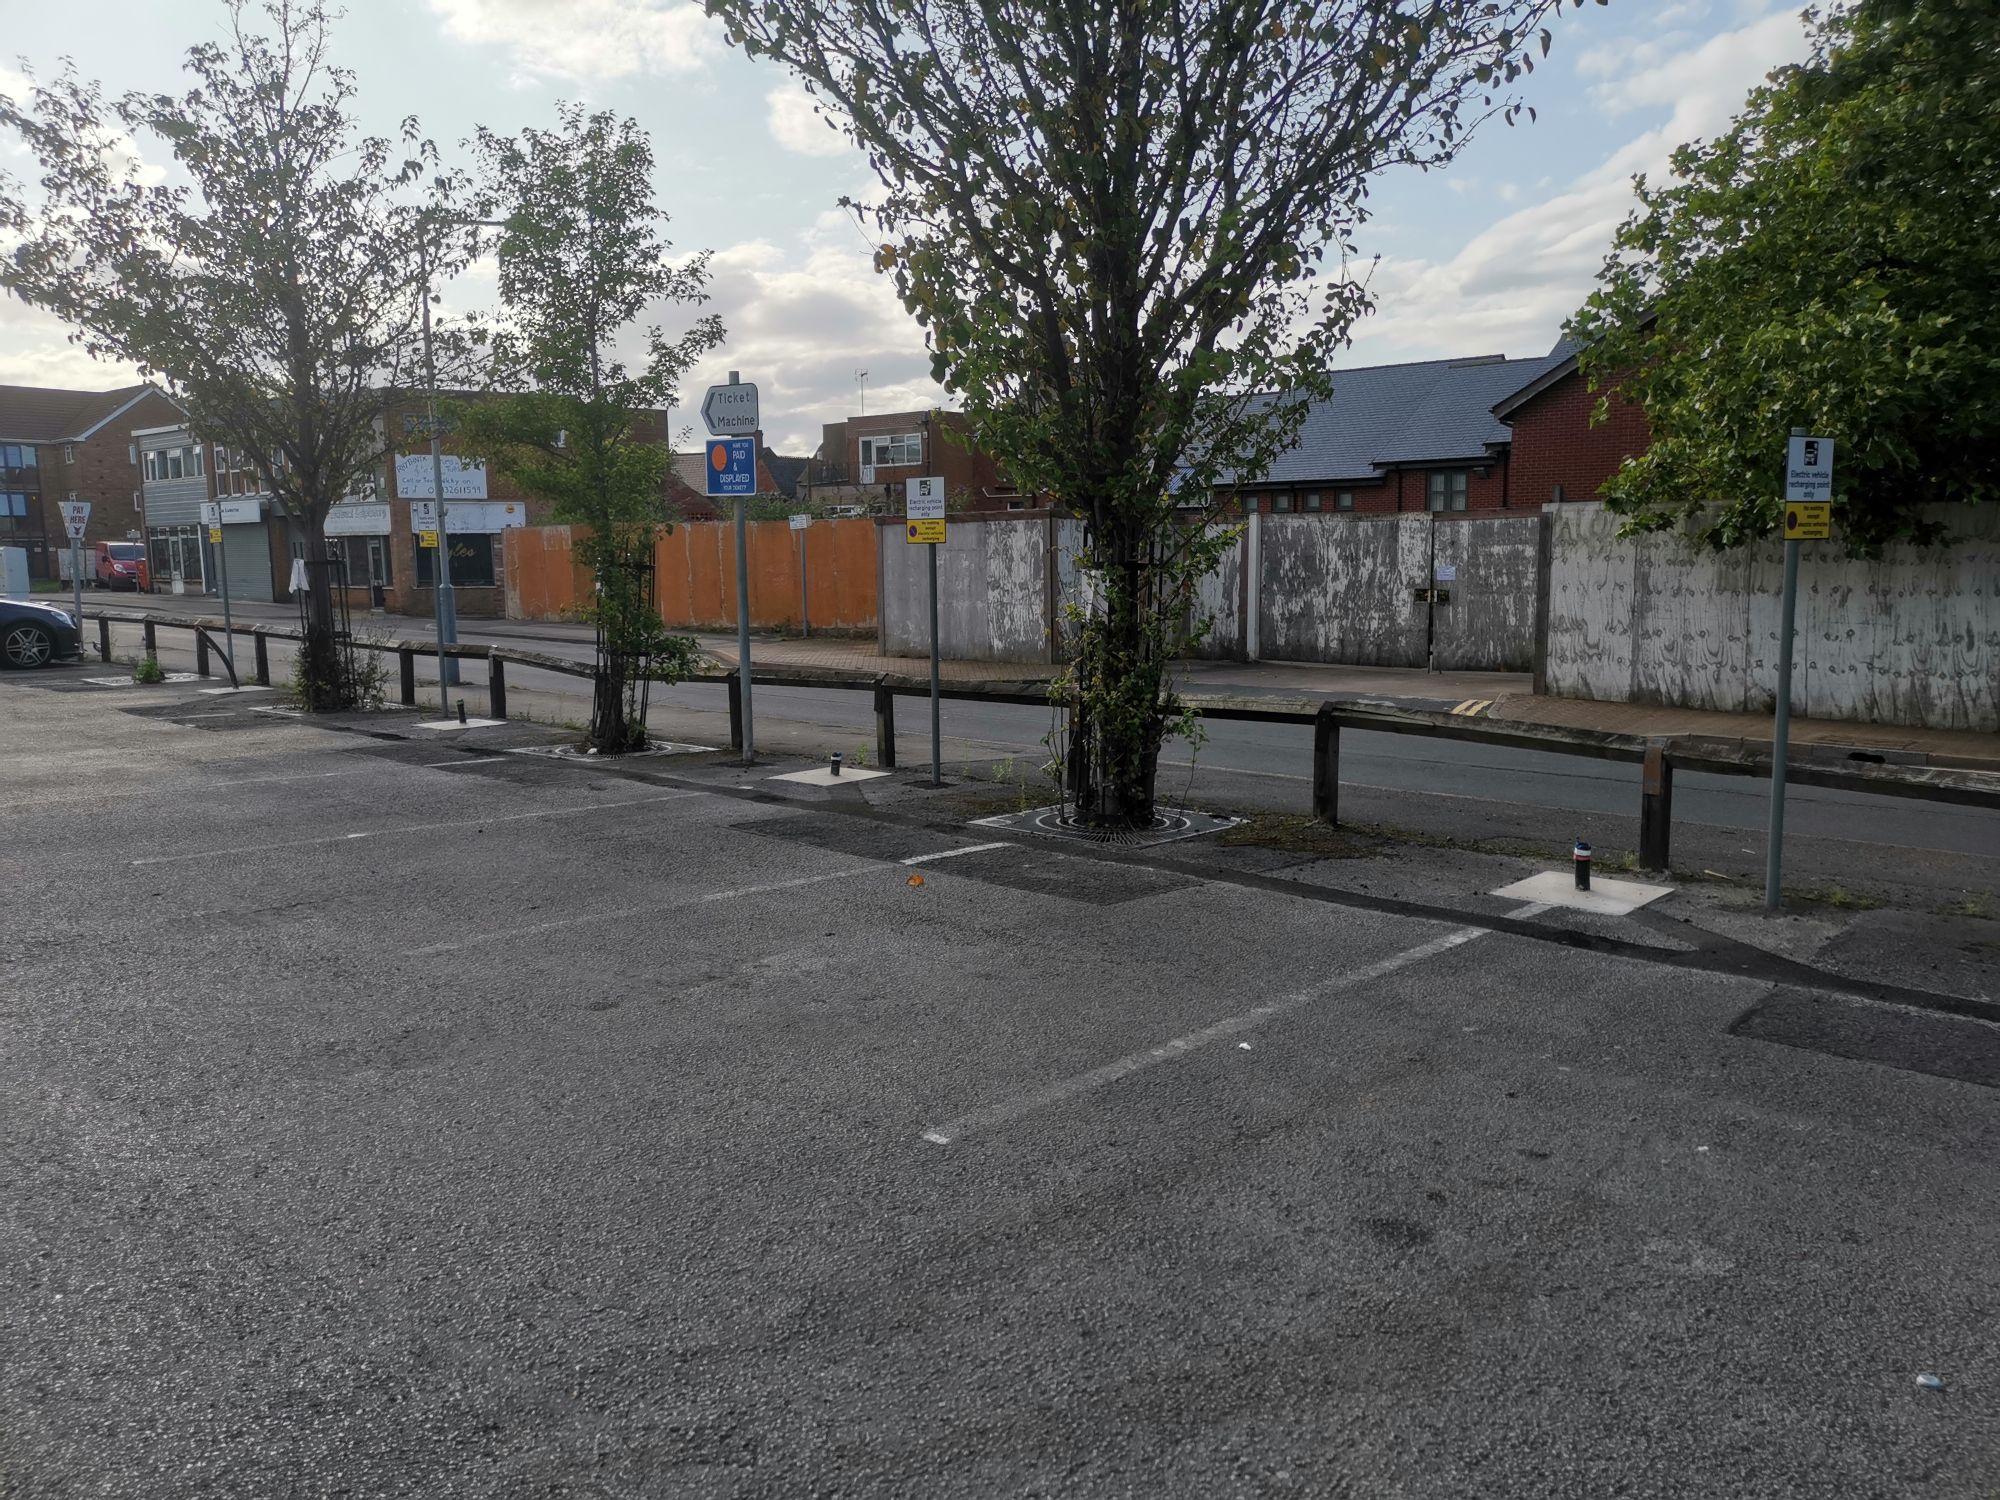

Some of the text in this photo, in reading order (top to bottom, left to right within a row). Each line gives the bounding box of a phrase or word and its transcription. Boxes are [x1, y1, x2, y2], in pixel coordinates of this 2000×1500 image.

[718, 392, 750, 404] Ticket
[718, 416, 755, 427] Machine
[732, 451, 745, 460] PAID
[733, 462, 738, 472] &
[720, 474, 750, 483] DISPLAYED
[72, 506, 84, 514] PAY
[70, 516, 86, 524] HERE
